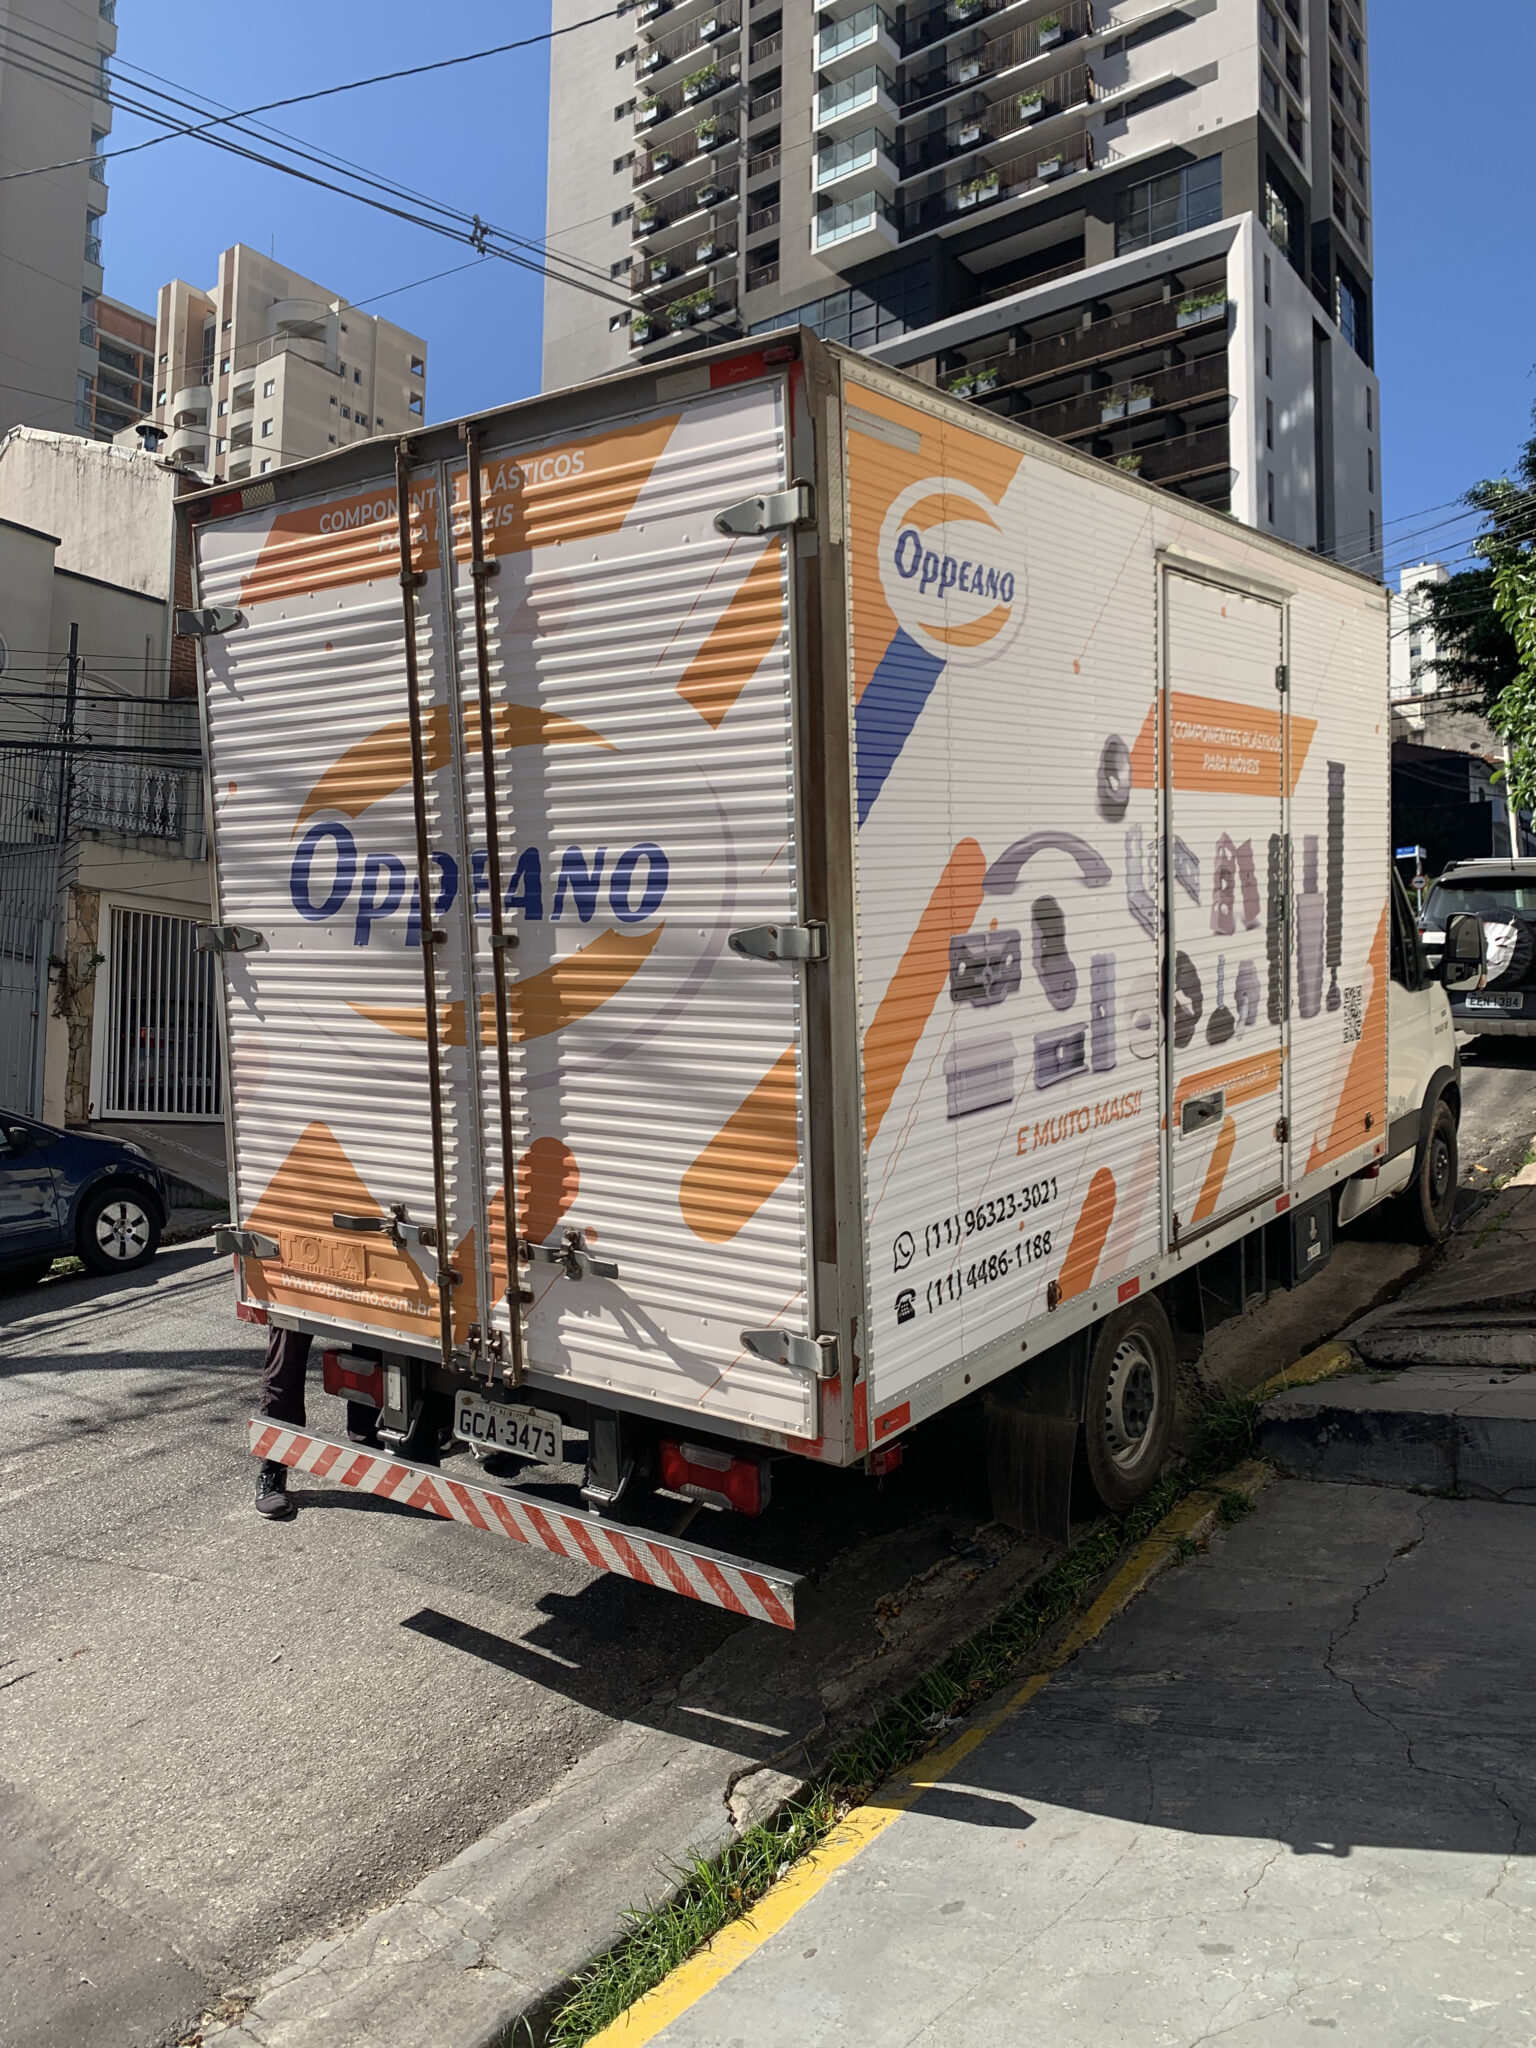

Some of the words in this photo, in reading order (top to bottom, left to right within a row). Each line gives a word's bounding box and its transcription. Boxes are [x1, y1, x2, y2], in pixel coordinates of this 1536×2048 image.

[319, 481, 460, 534] COMPONNTS
[1173, 720, 1241, 747] COMPONENTES
[1203, 753, 1227, 771] PARA
[1230, 753, 1260, 775] MÓVEIS
[1016, 1125, 1030, 1156] E
[1032, 1106, 1090, 1151] MUITO
[1094, 1089, 1142, 1129] MAIS!!
[924, 1214, 960, 1256] (11)
[965, 1177, 1058, 1237] 96323-3021
[281, 1231, 363, 1275] TOTA
[926, 1269, 962, 1313] (11)
[967, 1230, 1052, 1289] 4486-1188
[281, 1273, 433, 1317] www.oppeano.com.br
